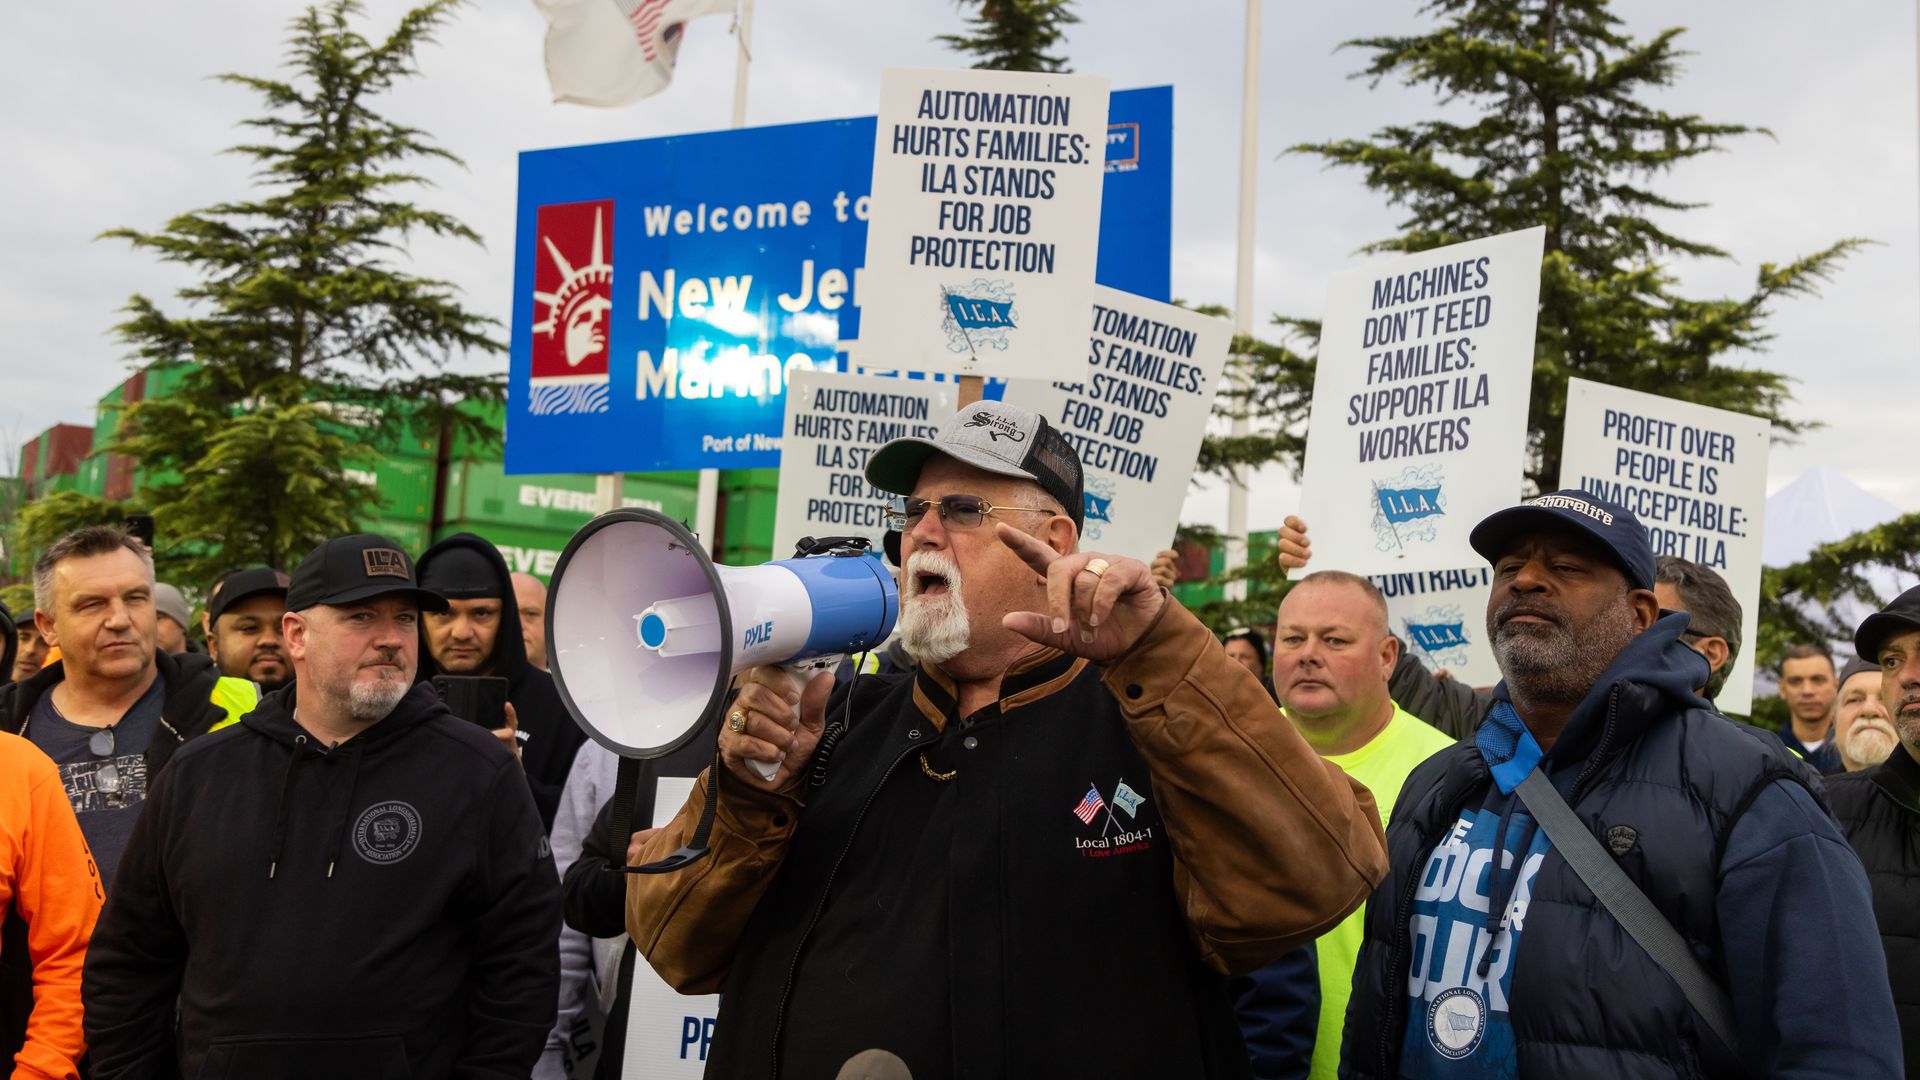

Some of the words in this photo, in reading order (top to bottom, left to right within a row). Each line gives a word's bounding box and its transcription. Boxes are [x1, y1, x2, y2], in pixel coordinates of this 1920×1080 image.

[917, 89, 1071, 127] AUTOMATION
[892, 124, 970, 158] HURTS
[975, 128, 1091, 165] FAMILIES:
[921, 162, 957, 194] ILA
[963, 166, 1056, 200] STANDS
[644, 200, 811, 238] Welcome
[833, 191, 871, 223] to
[938, 200, 984, 233] FOR
[988, 203, 1032, 235] JOB
[910, 235, 1056, 274] PROTECTION
[638, 269, 753, 320] New
[1371, 256, 1490, 310] MACHINES
[1091, 303, 1198, 358] TOMATION
[1362, 306, 1430, 349] DON'T
[1432, 295, 1492, 336] FEED
[1105, 342, 1207, 396] FAMILIES:
[1366, 337, 1477, 385] FAMILIES:
[813, 388, 929, 421] AUTOMATION
[1089, 373, 1172, 419] STANDS
[1347, 379, 1450, 426] SUPPORT
[1453, 373, 1490, 411] ILA
[794, 413, 853, 444] HURTS
[1061, 398, 1104, 434] FOR
[1103, 411, 1145, 444] JOB
[1359, 416, 1472, 463] WORKERS
[1603, 408, 1677, 451] PROFIT
[1680, 426, 1736, 465] OVER
[702, 435, 733, 453] Port
[735, 433, 752, 451] of
[816, 443, 843, 469] ILA
[829, 472, 864, 498] FOR
[1615, 447, 1694, 491] PEOPLE
[1699, 465, 1719, 496] IS
[1387, 494, 1437, 515] I.L.A.
[1695, 536, 1727, 569] ILA
[744, 620, 773, 649] PYLE
[1075, 836, 1110, 849] Local
[1113, 827, 1152, 846] 1804-1
[1089, 847, 1111, 857] Love
[1112, 842, 1150, 855] America
[1428, 989, 1462, 1029] INTERNATIONAL
